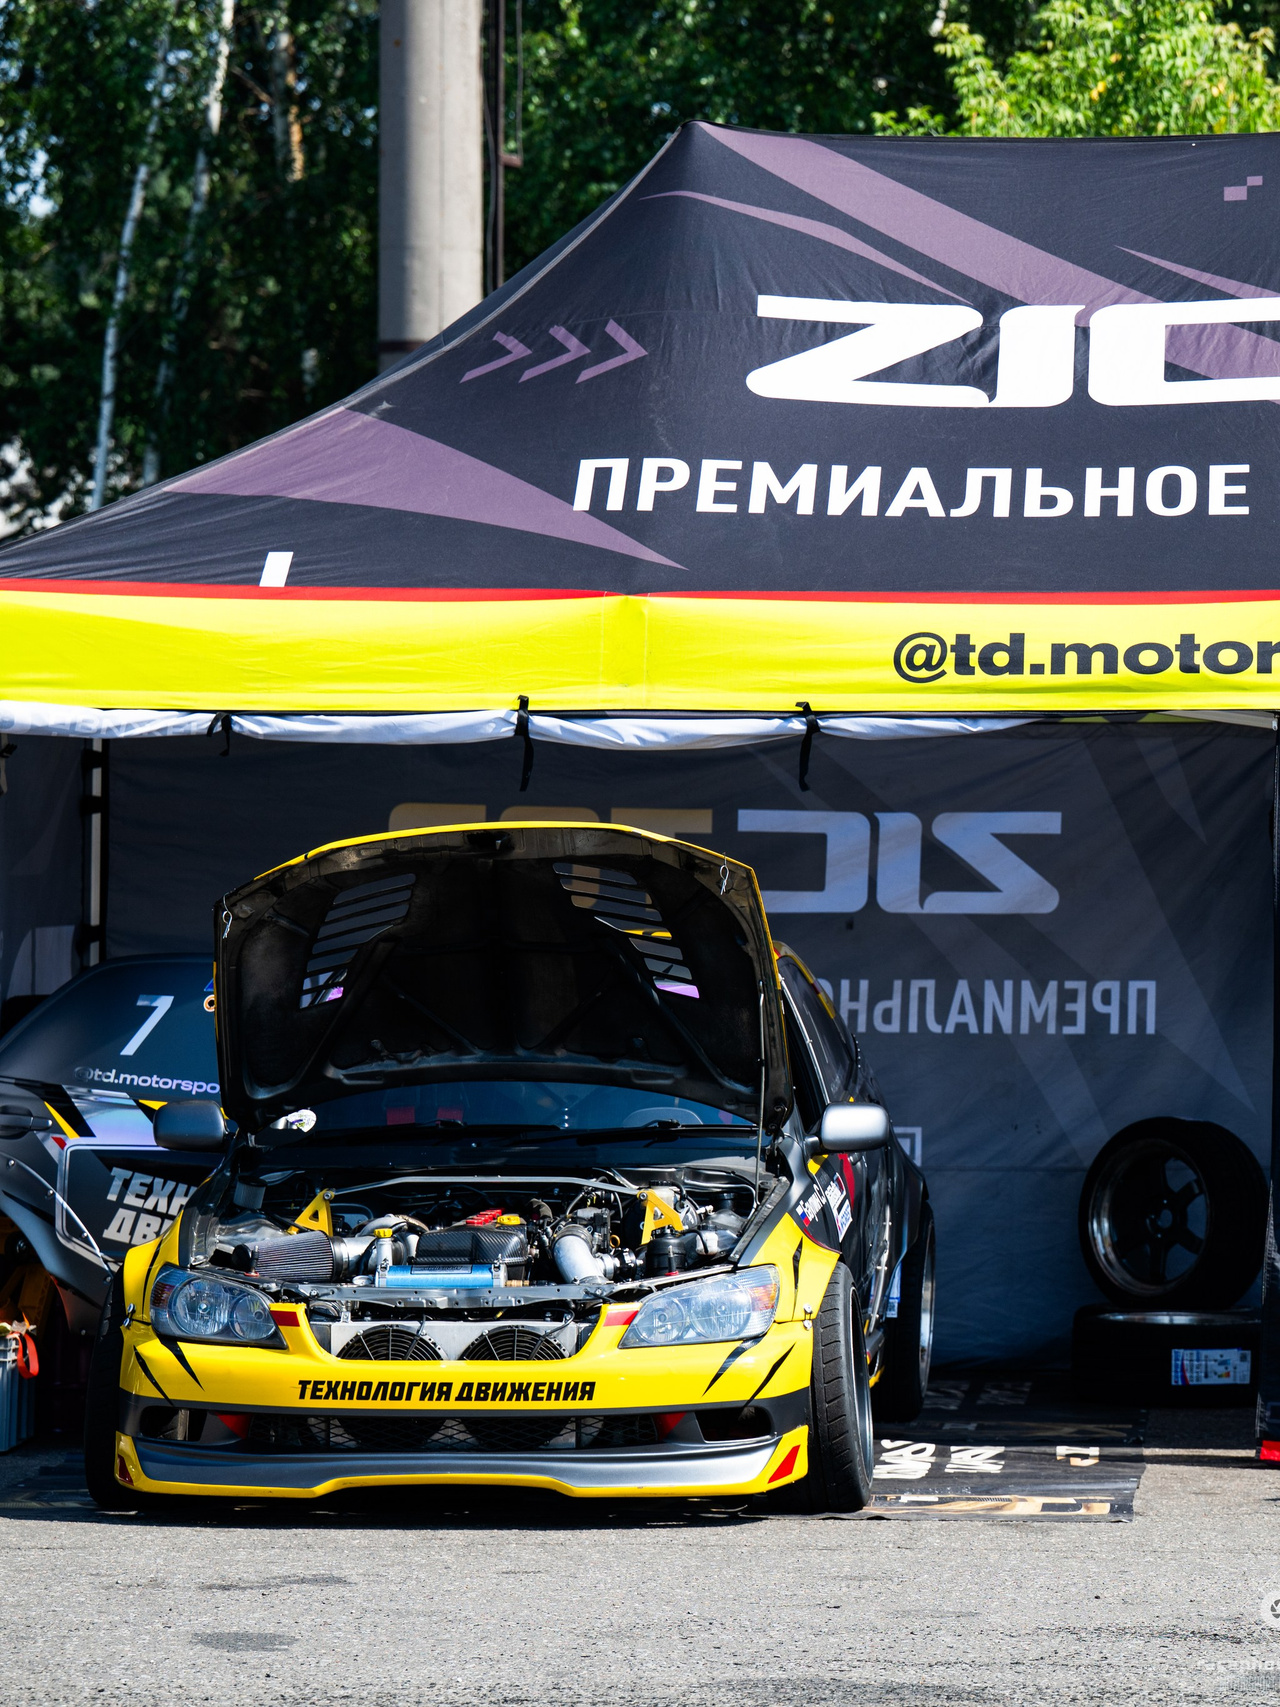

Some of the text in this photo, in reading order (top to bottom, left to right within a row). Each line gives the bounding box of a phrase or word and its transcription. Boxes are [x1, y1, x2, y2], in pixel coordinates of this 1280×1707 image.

[573, 457, 1250, 518] ПРЕМИАЛЬНОЕ
[120, 994, 174, 1056] 7
[74, 1066, 221, 1095] @td.motorspo
[298, 1380, 597, 1402] ТЕХНОЛОГИЯ ДВИЖЕНИЯ
